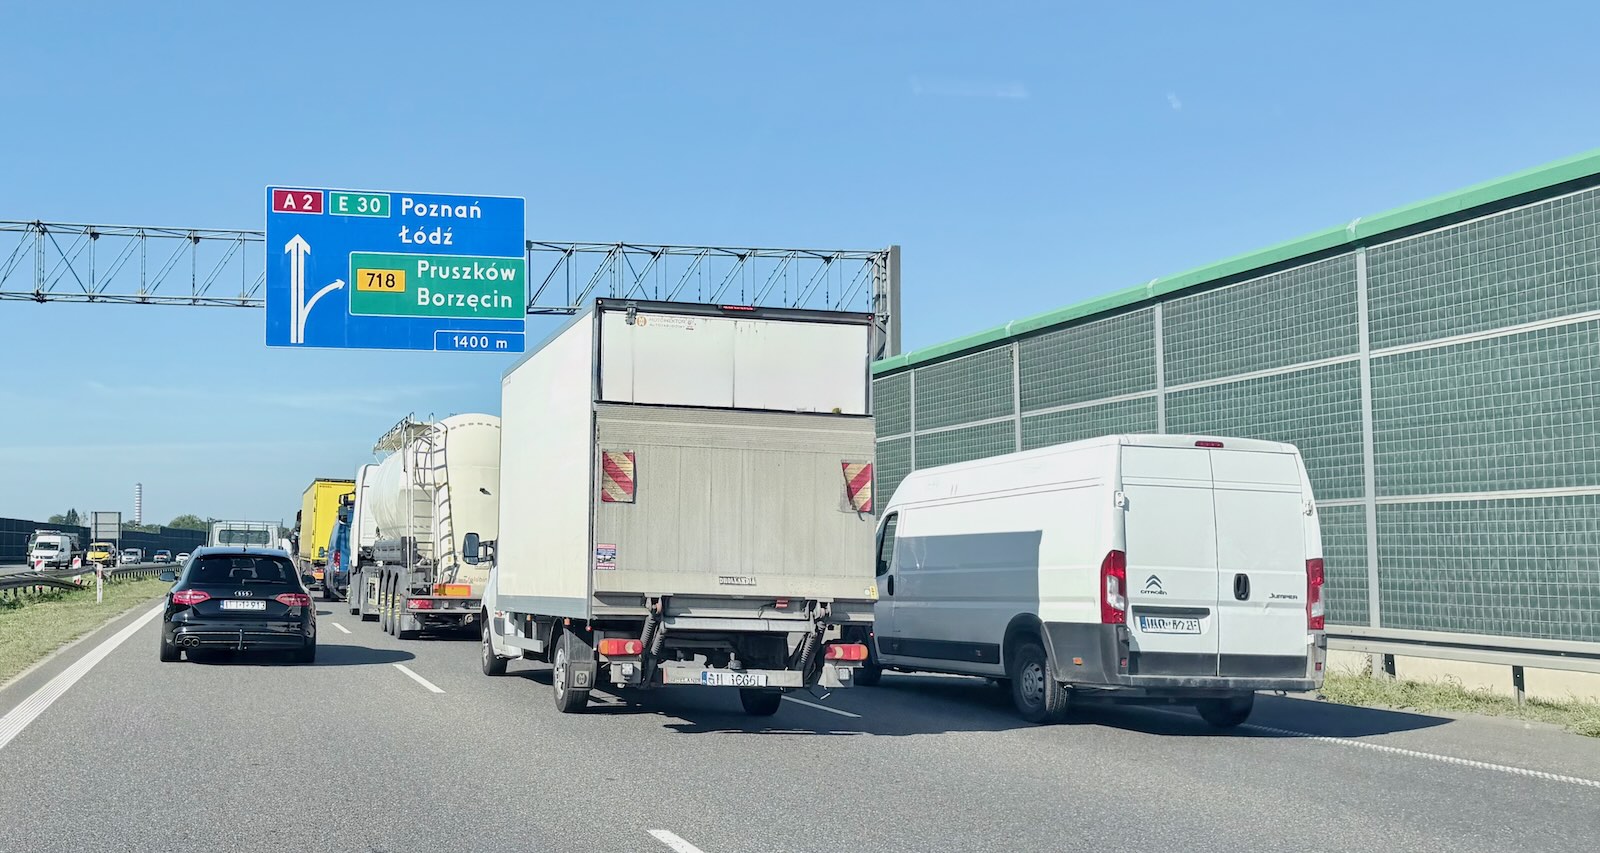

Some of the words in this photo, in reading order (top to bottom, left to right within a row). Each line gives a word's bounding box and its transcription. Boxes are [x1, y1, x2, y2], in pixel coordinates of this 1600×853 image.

[283, 193, 296, 209] A
[302, 194, 313, 210] 2
[339, 196, 349, 212] E
[357, 197, 381, 213] 30
[401, 197, 482, 219] Poznań
[398, 225, 454, 245] Łódź
[417, 260, 516, 281] Pruszków
[366, 272, 396, 288] 718
[417, 287, 513, 312] Borzęcin
[453, 336, 489, 348] 1400
[496, 339, 508, 349] m
